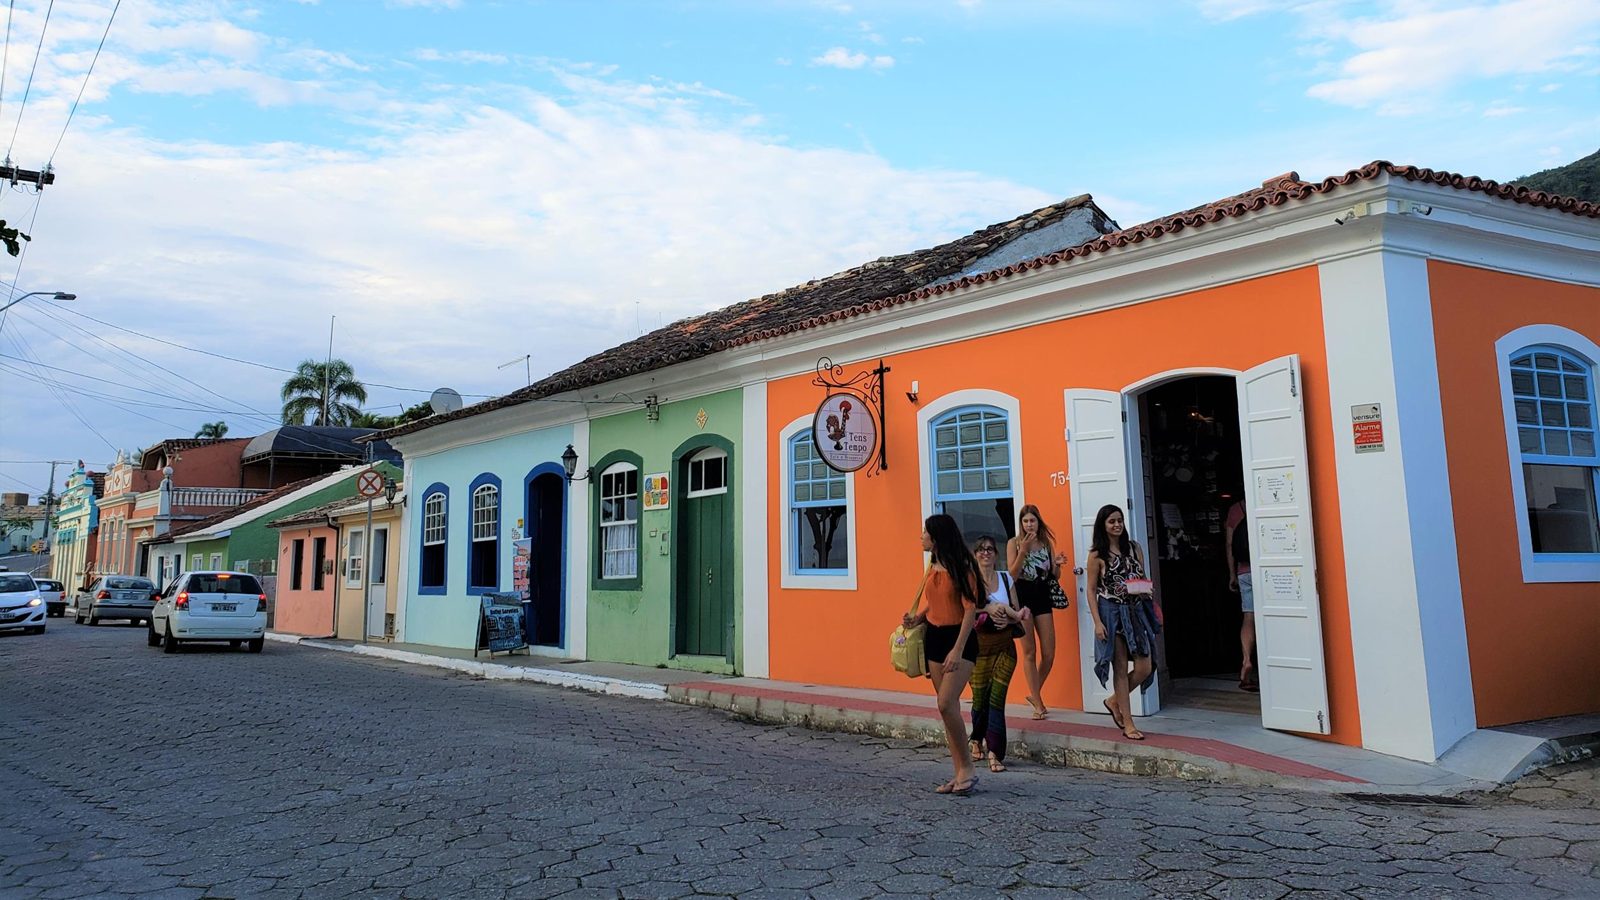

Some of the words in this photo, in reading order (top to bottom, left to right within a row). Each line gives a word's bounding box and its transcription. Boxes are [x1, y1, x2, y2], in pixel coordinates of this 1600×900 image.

[1354, 424, 1381, 432] Alarme
[849, 432, 867, 442] Tens
[844, 441, 867, 453] Tempo
